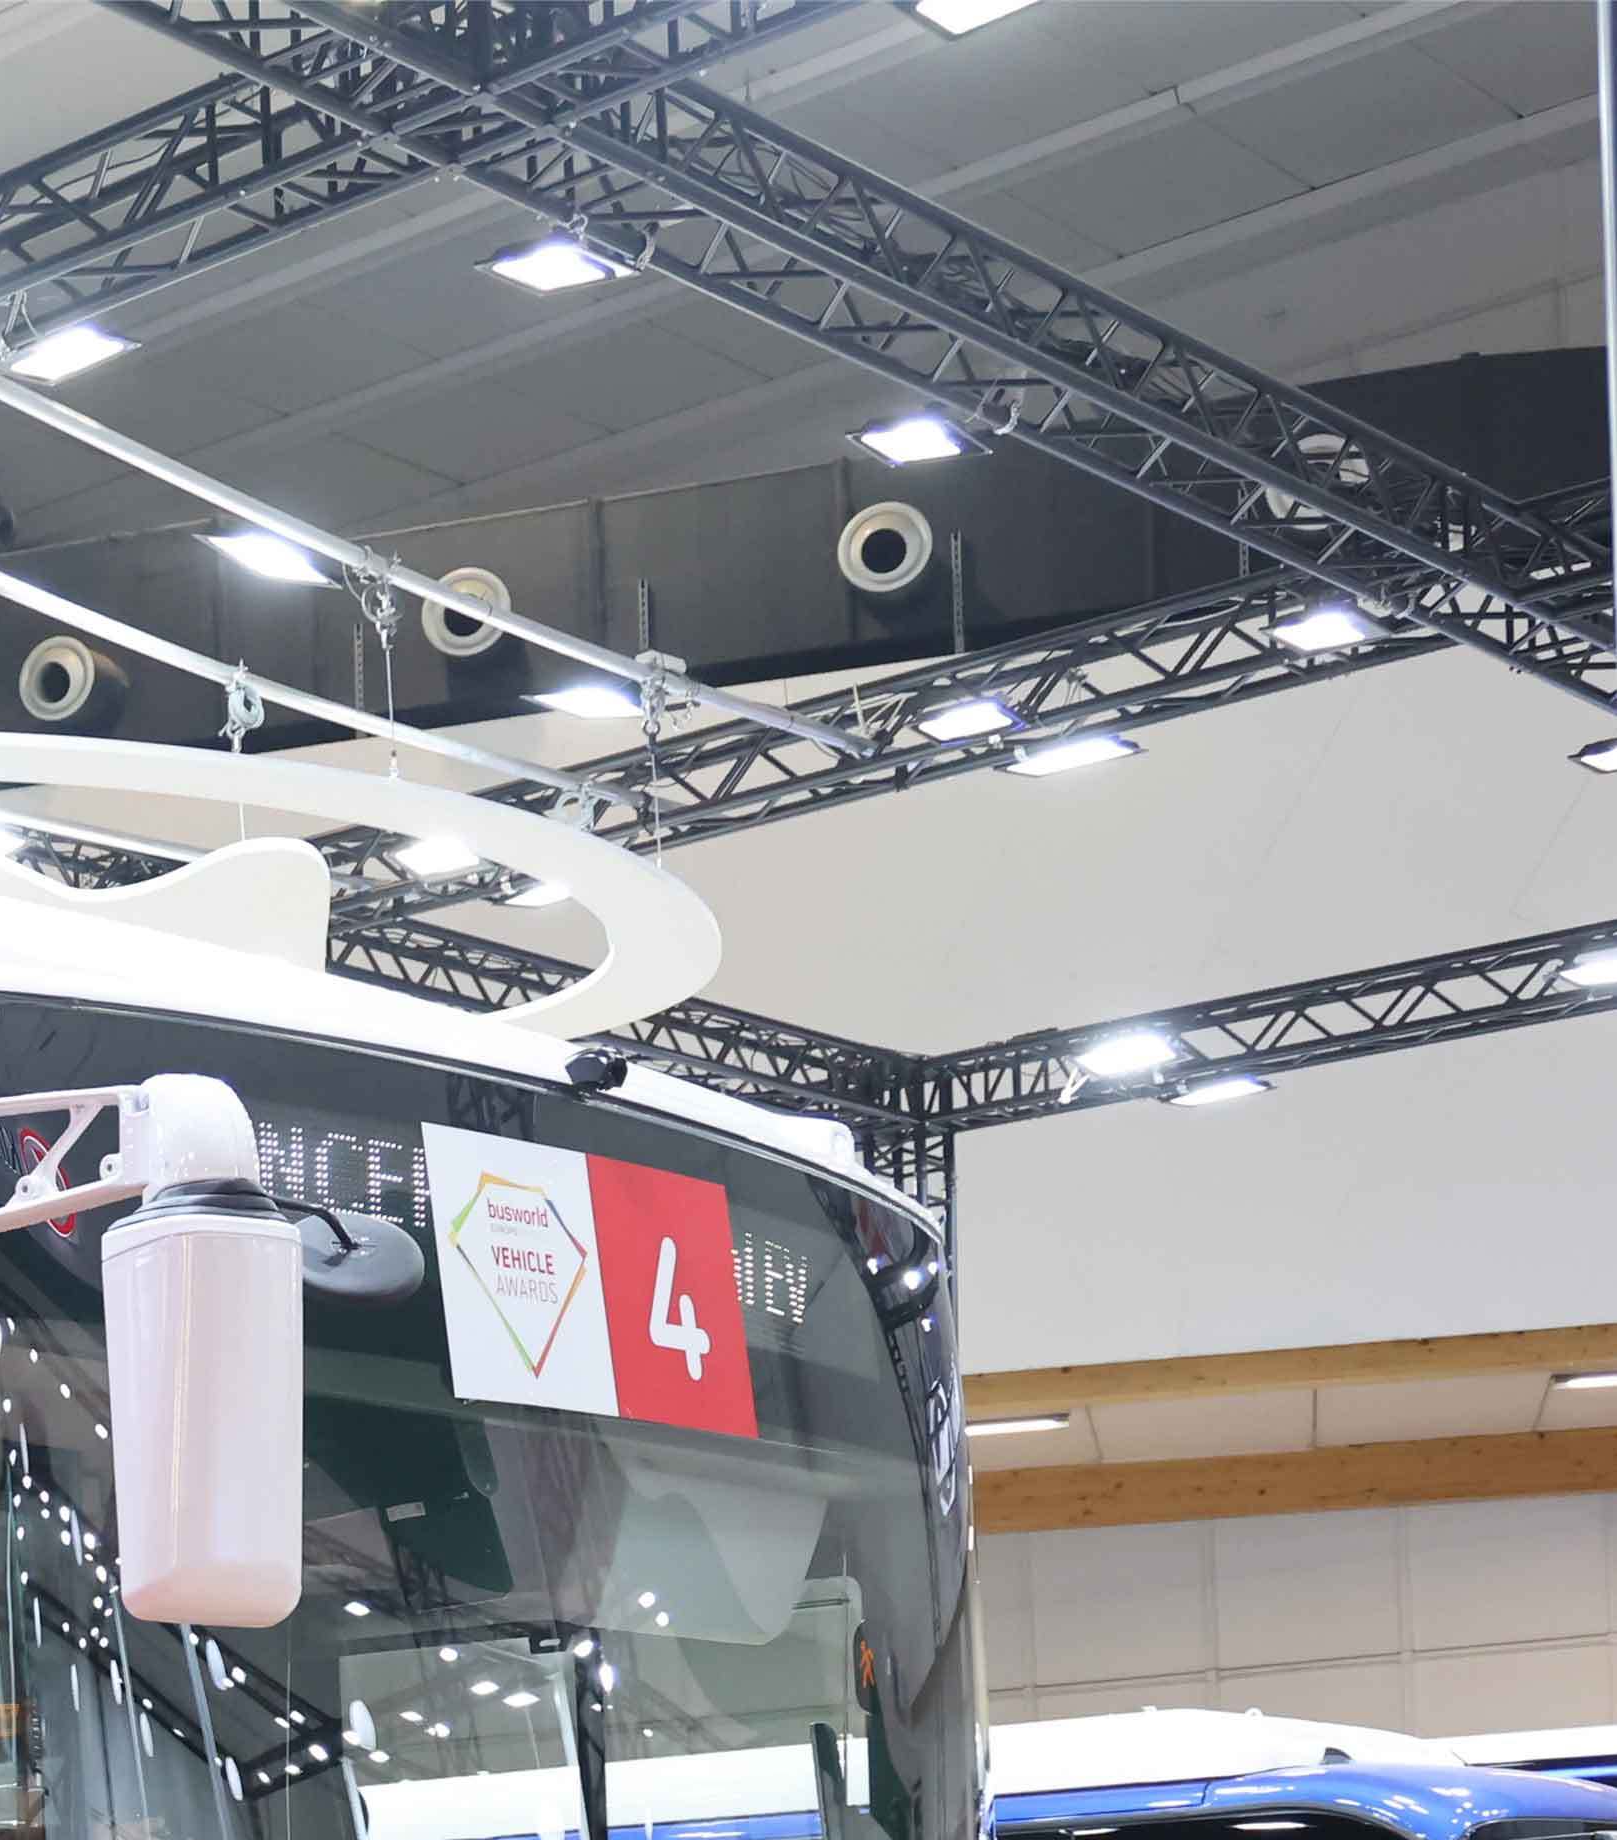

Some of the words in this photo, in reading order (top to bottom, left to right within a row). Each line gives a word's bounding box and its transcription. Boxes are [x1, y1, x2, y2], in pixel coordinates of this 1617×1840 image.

[259, 1122, 430, 1227] NCE
[487, 1197, 549, 1228] busworld
[491, 1244, 555, 1275] VEHICLE
[496, 1273, 559, 1305] AWARDS
[649, 1236, 711, 1382] 4
